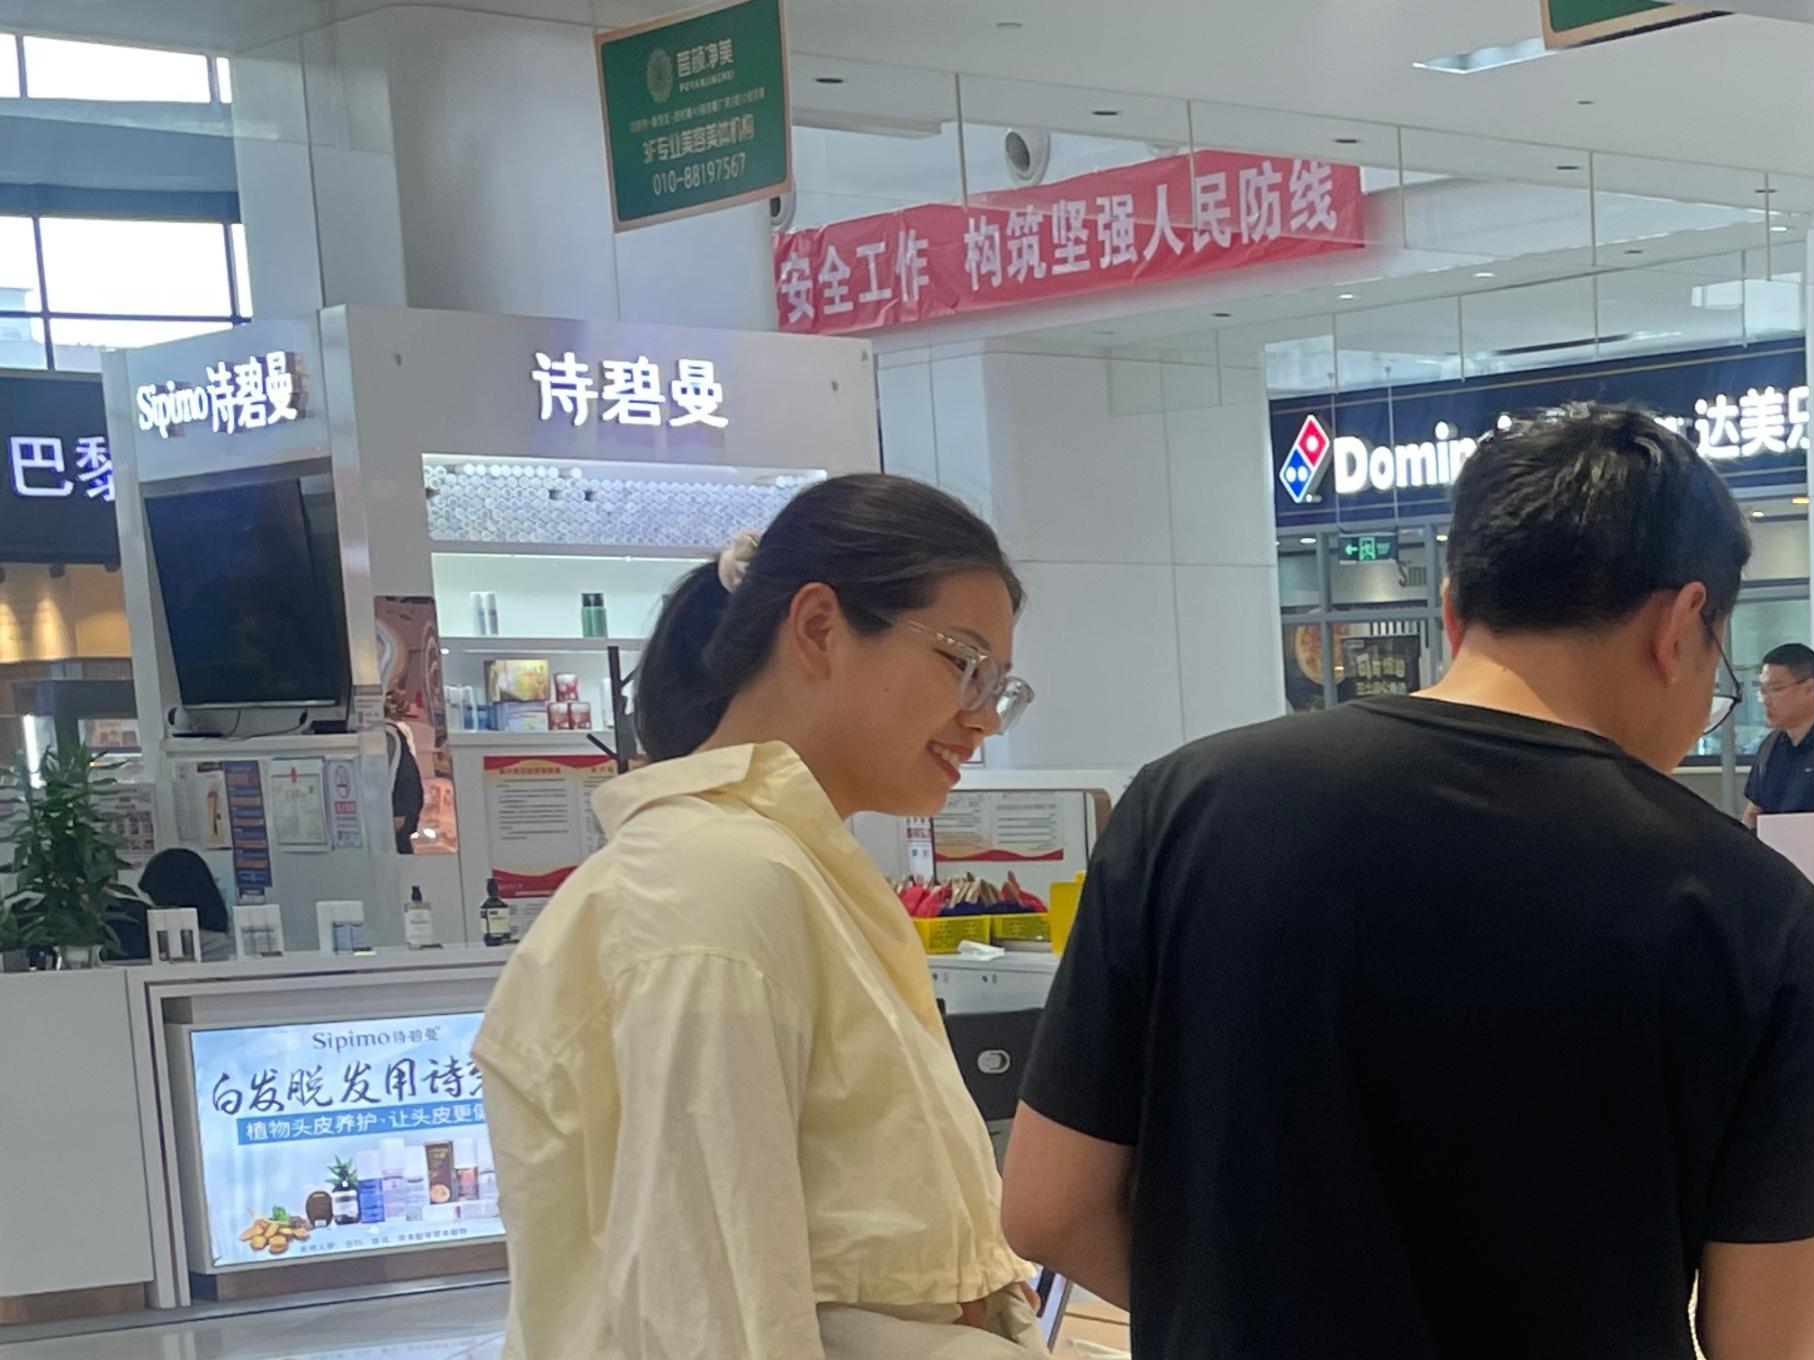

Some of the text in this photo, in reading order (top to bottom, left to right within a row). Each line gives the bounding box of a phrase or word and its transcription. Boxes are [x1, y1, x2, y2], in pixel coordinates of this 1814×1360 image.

[653, 152, 746, 196] 010-88197567
[779, 160, 1338, 323] 安全工作 构筑坚强人民防线
[532, 352, 729, 428] 诗碧曼
[312, 1029, 391, 1052] Sipimo
